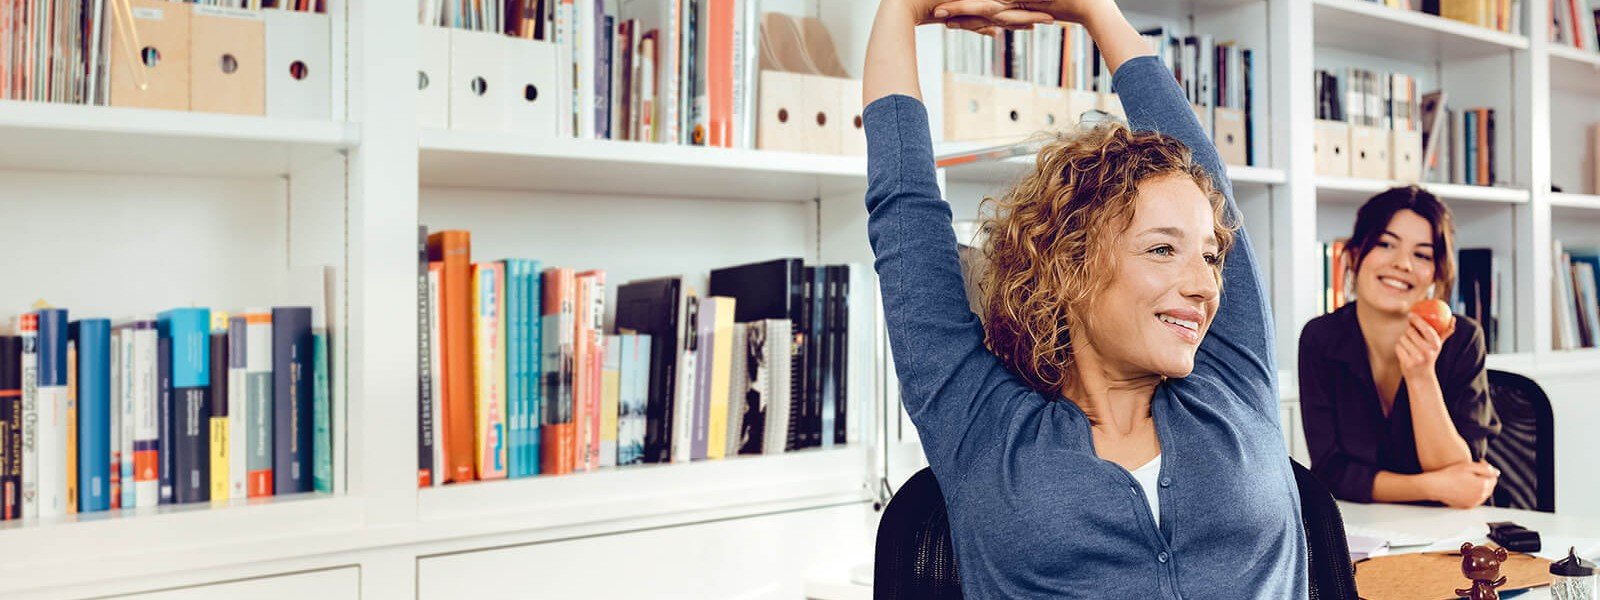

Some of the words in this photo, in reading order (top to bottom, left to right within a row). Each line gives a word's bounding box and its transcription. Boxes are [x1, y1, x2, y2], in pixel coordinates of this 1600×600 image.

[419, 275, 432, 446] UNTERNEHMENSKOMMUNIKATION
[24, 366, 36, 410] Leading
[257, 375, 265, 425] Management
[22, 413, 37, 453] Change
[257, 427, 265, 456] Change
